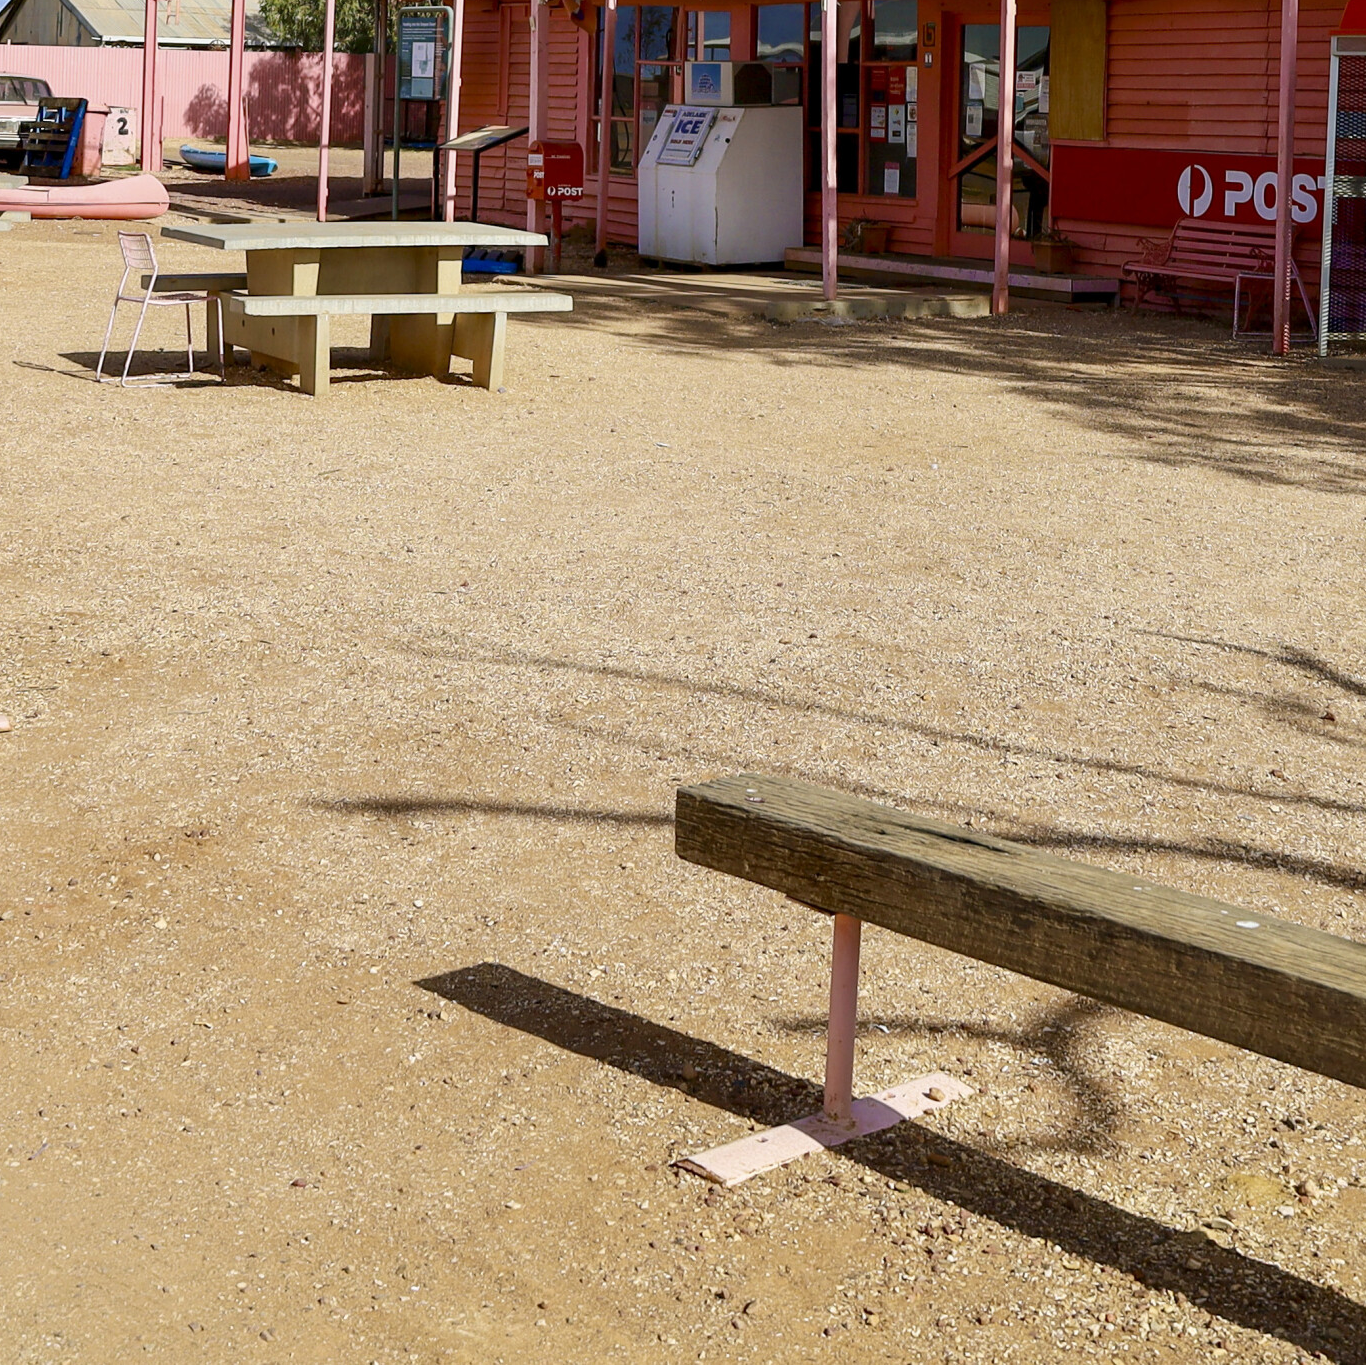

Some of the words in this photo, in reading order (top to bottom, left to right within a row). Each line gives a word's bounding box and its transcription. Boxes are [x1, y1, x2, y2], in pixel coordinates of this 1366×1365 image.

[116, 117, 129, 135] 2
[674, 119, 705, 134] ICE
[557, 187, 583, 196] POST
